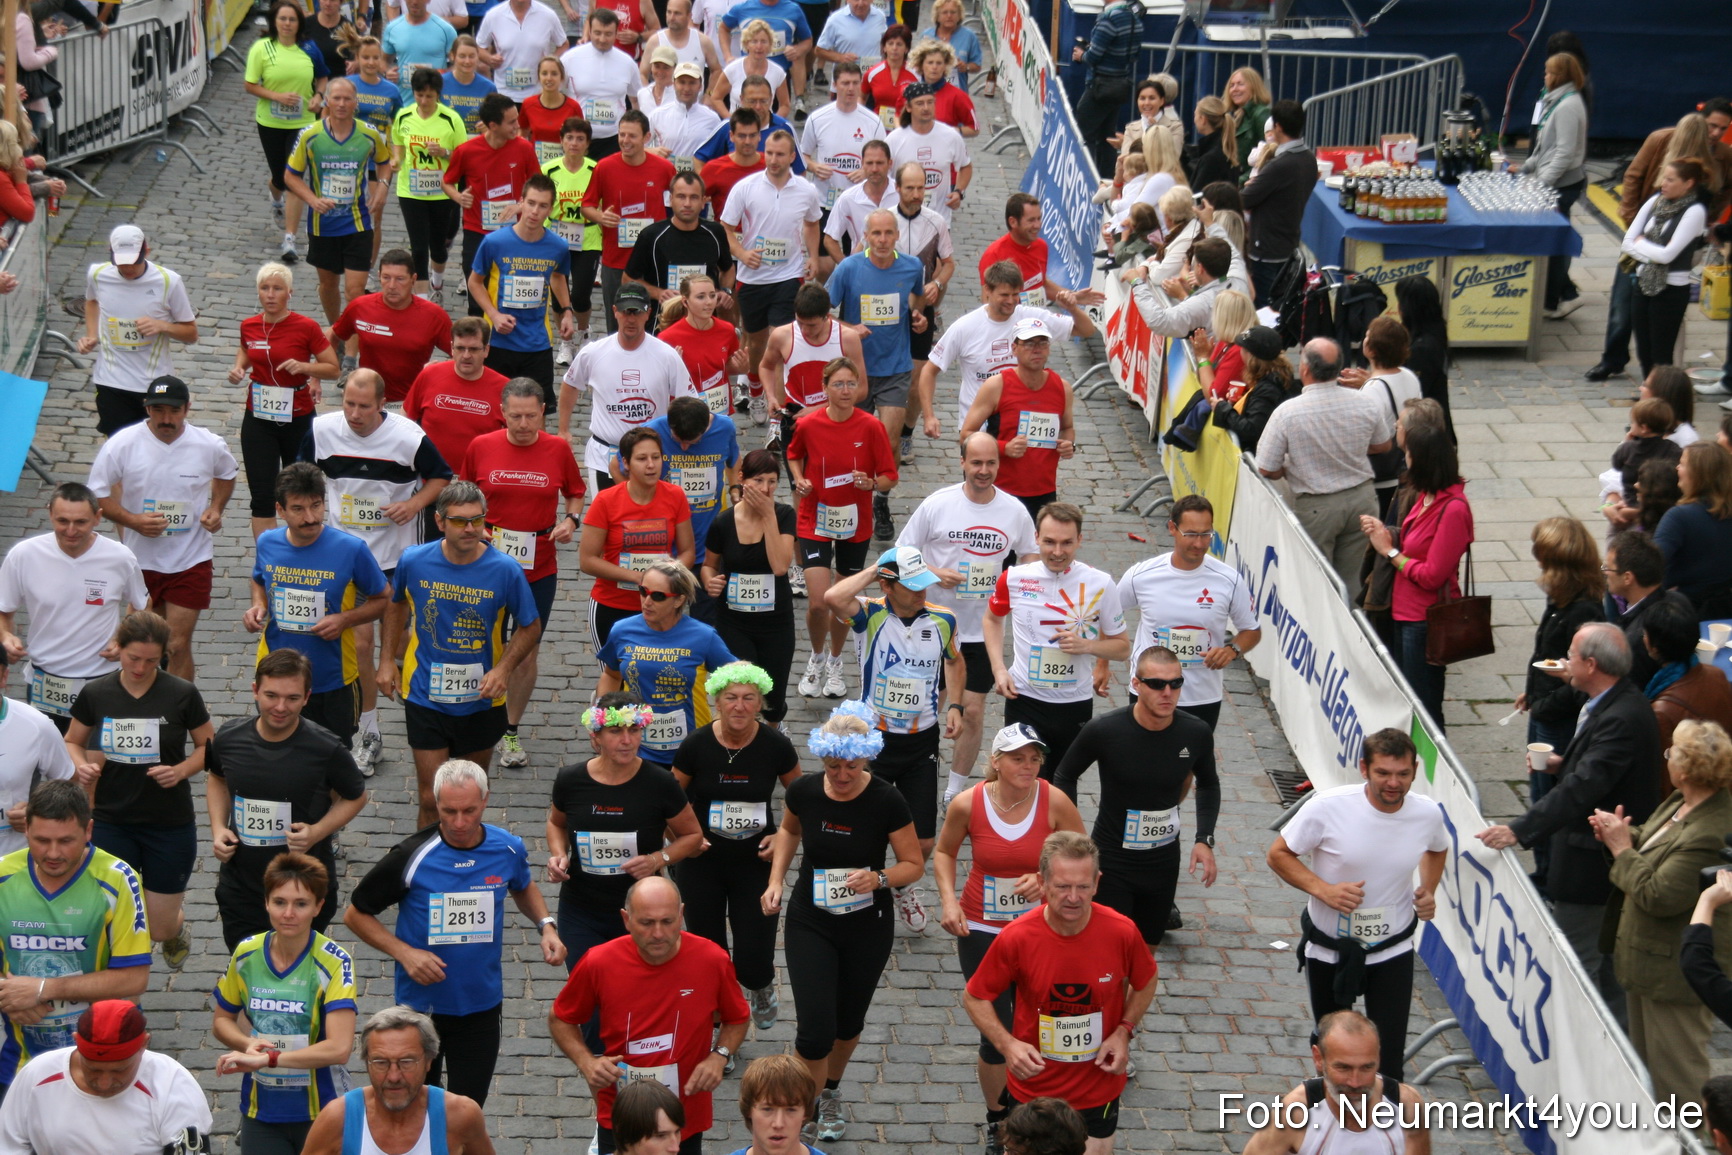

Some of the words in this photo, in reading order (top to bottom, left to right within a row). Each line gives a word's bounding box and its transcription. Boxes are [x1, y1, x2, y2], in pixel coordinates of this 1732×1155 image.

[514, 76, 532, 84] 3421
[280, 105, 300, 113] 2292
[594, 110, 614, 118] 3406
[410, 134, 440, 144] Müller
[418, 150, 434, 164] M
[320, 162, 358, 170] BOCK
[331, 185, 352, 194] 3194
[418, 180, 441, 188] 2080
[567, 206, 582, 220] M
[558, 232, 580, 243] 2112
[764, 248, 786, 256] 3411
[511, 263, 548, 272] STADTLAUF
[1452, 260, 1531, 298] Glossner
[515, 288, 539, 297] 3566
[1493, 282, 1528, 298] Bier
[871, 298, 884, 306] Jörg
[875, 306, 894, 316] 533
[986, 355, 1016, 364] SEAT
[155, 384, 168, 393] CAT
[262, 388, 270, 396] Evi
[262, 399, 289, 412] 2127
[444, 396, 488, 409] Frankenflitzer
[710, 398, 728, 411] 2545
[606, 404, 648, 414] GERHART
[1030, 426, 1056, 438] 2118
[671, 454, 722, 463] NEUMARKTER
[670, 462, 714, 470] STADTLAUF
[499, 472, 548, 482] Frankenflitzer
[684, 480, 712, 492] 3221
[157, 503, 176, 511] Josef
[354, 498, 375, 507] Stefan
[358, 510, 382, 521] 936
[828, 508, 840, 517] Gabi
[828, 518, 854, 528] 2574
[502, 532, 519, 542] Klaus
[948, 530, 997, 542] GERHART
[506, 544, 528, 557] 710
[970, 540, 1003, 550] JANIG
[265, 564, 274, 572] 10.
[274, 566, 335, 580] NEUMARKTER
[972, 566, 984, 574] Uwe
[272, 574, 322, 586] STADTLAUF
[740, 578, 761, 586] Stefani
[972, 576, 996, 587] 3428
[419, 580, 431, 589] 10.
[432, 582, 494, 600] NEUMARKTER
[740, 588, 770, 599] 2515
[287, 592, 316, 603] Siegfried
[430, 590, 482, 606] STADTLAUF
[288, 605, 317, 618] 3231
[1172, 632, 1191, 642] Bernd
[634, 646, 692, 657] NEUMARKTER
[1172, 644, 1202, 656] 3439
[631, 652, 678, 662] STADTLAUF
[904, 658, 936, 668] PLAST
[446, 667, 466, 676] Bernd
[1044, 664, 1074, 675] 3824
[46, 678, 66, 689] Martin
[445, 678, 478, 690] 2140
[889, 680, 912, 690] Hubert
[46, 689, 76, 704] 2386
[888, 692, 920, 705] 3750
[115, 722, 136, 732] Steffi
[650, 726, 683, 739] 2139
[116, 736, 152, 749] 2332
[247, 802, 270, 814] Tobias
[726, 804, 742, 814] Rosa
[726, 818, 760, 830] 3525
[1142, 813, 1171, 824] Benjamin
[247, 818, 284, 831] 2315
[1142, 824, 1174, 838] 3693
[593, 836, 608, 845] Ines
[596, 848, 632, 859] 3538
[115, 861, 147, 932] BOCK
[448, 898, 478, 907] Thomas
[448, 912, 487, 926] 2813
[1354, 912, 1382, 921] Thomas
[12, 920, 46, 930] TEAM
[1354, 924, 1390, 936] 3532
[9, 934, 88, 950] BOCK
[324, 941, 353, 985] BOCK
[251, 986, 276, 994] TEAM
[250, 998, 304, 1014] BOCK
[1056, 1018, 1091, 1030] Raimund
[640, 1041, 660, 1050] DEHN
[1062, 1032, 1092, 1048] 919
